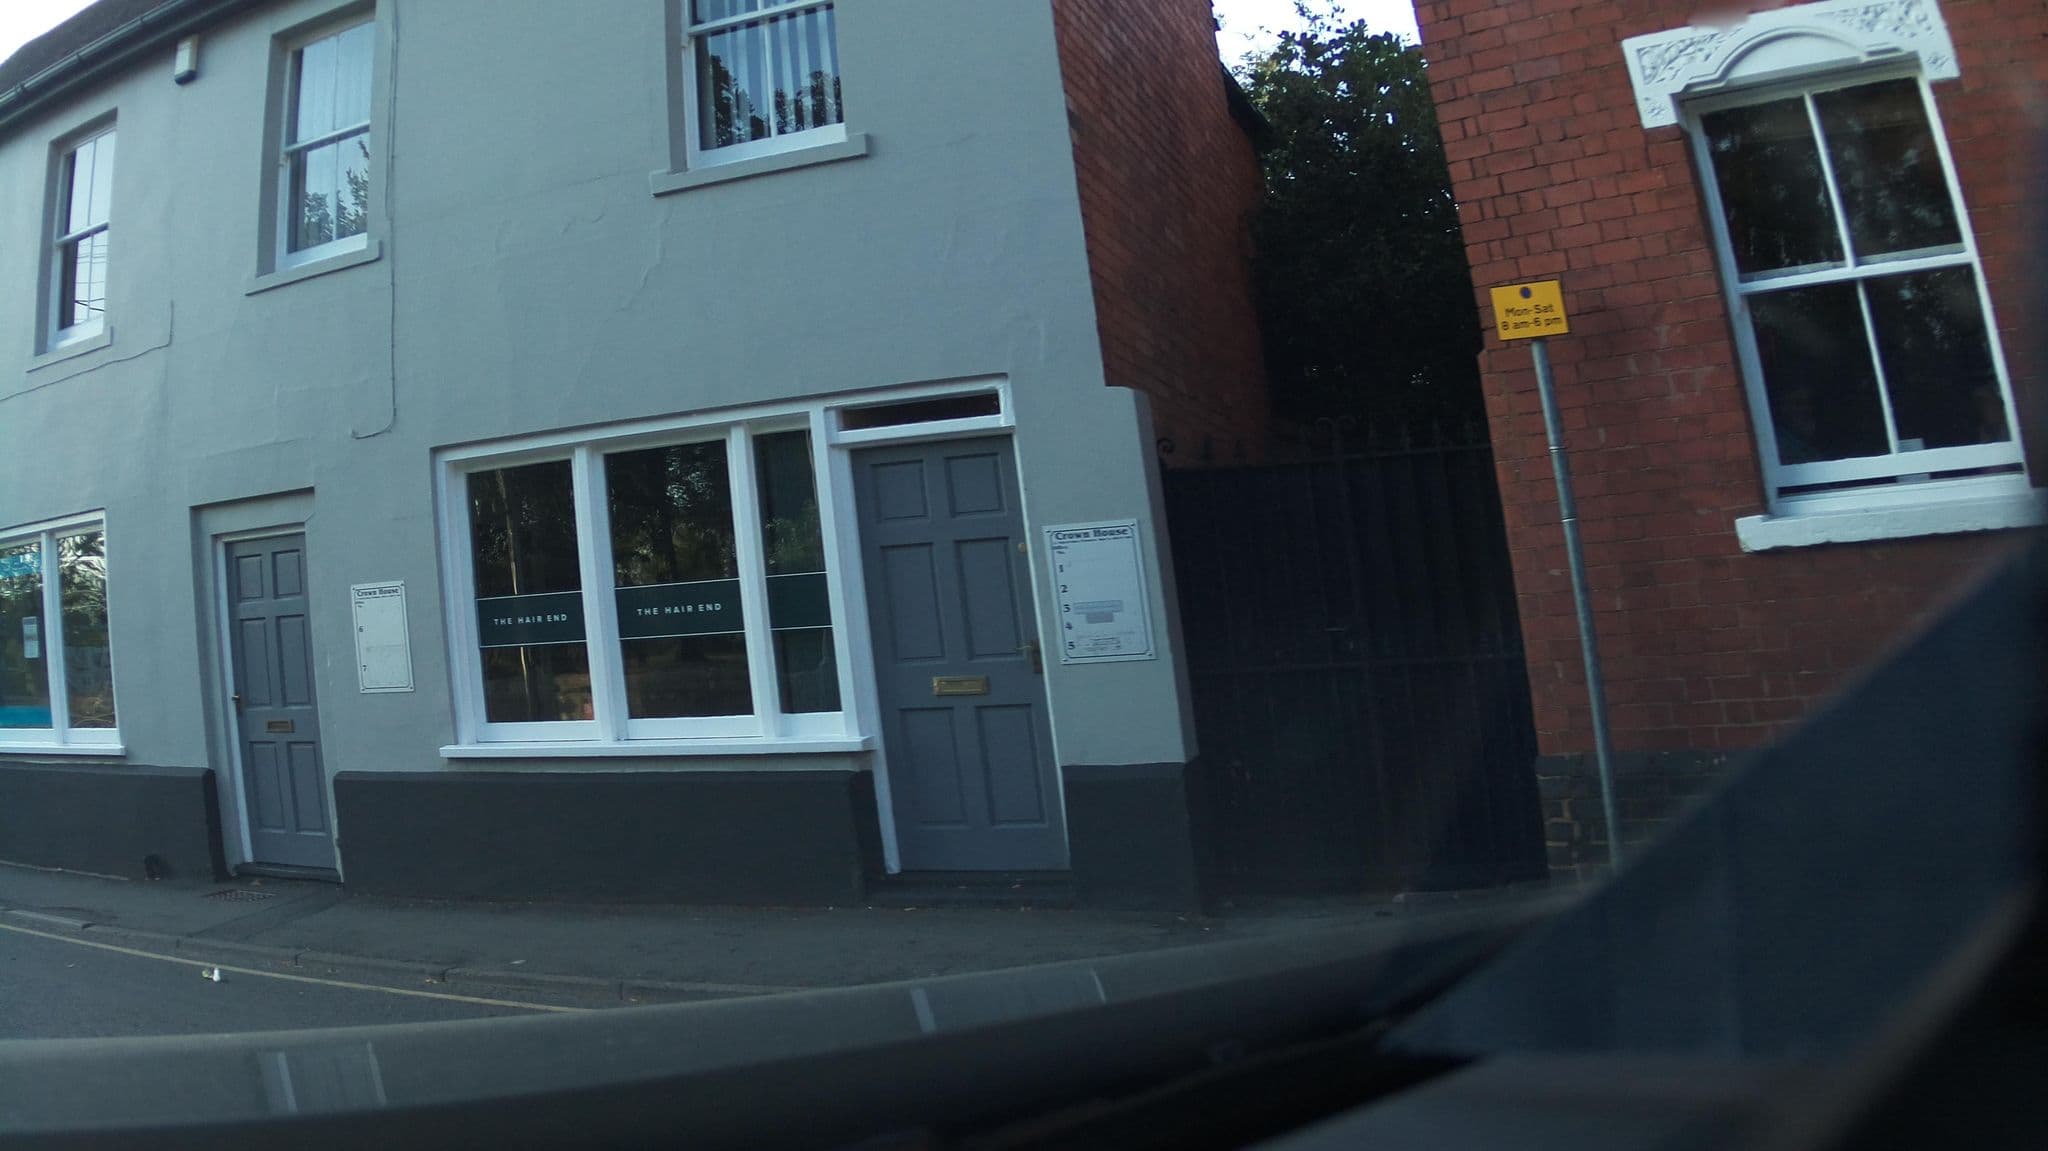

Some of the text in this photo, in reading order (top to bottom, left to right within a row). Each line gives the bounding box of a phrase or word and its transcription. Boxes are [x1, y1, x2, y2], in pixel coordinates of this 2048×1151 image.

[1505, 304, 1554, 317] Mon-Sat
[1501, 321, 1509, 331] 8
[1055, 532, 1090, 540] Crown
[1093, 528, 1129, 537] House
[1060, 584, 1068, 594] 2
[636, 603, 722, 616] THE HAIR END
[493, 613, 568, 626] THE HAIR END
[1068, 641, 1076, 650] 5
